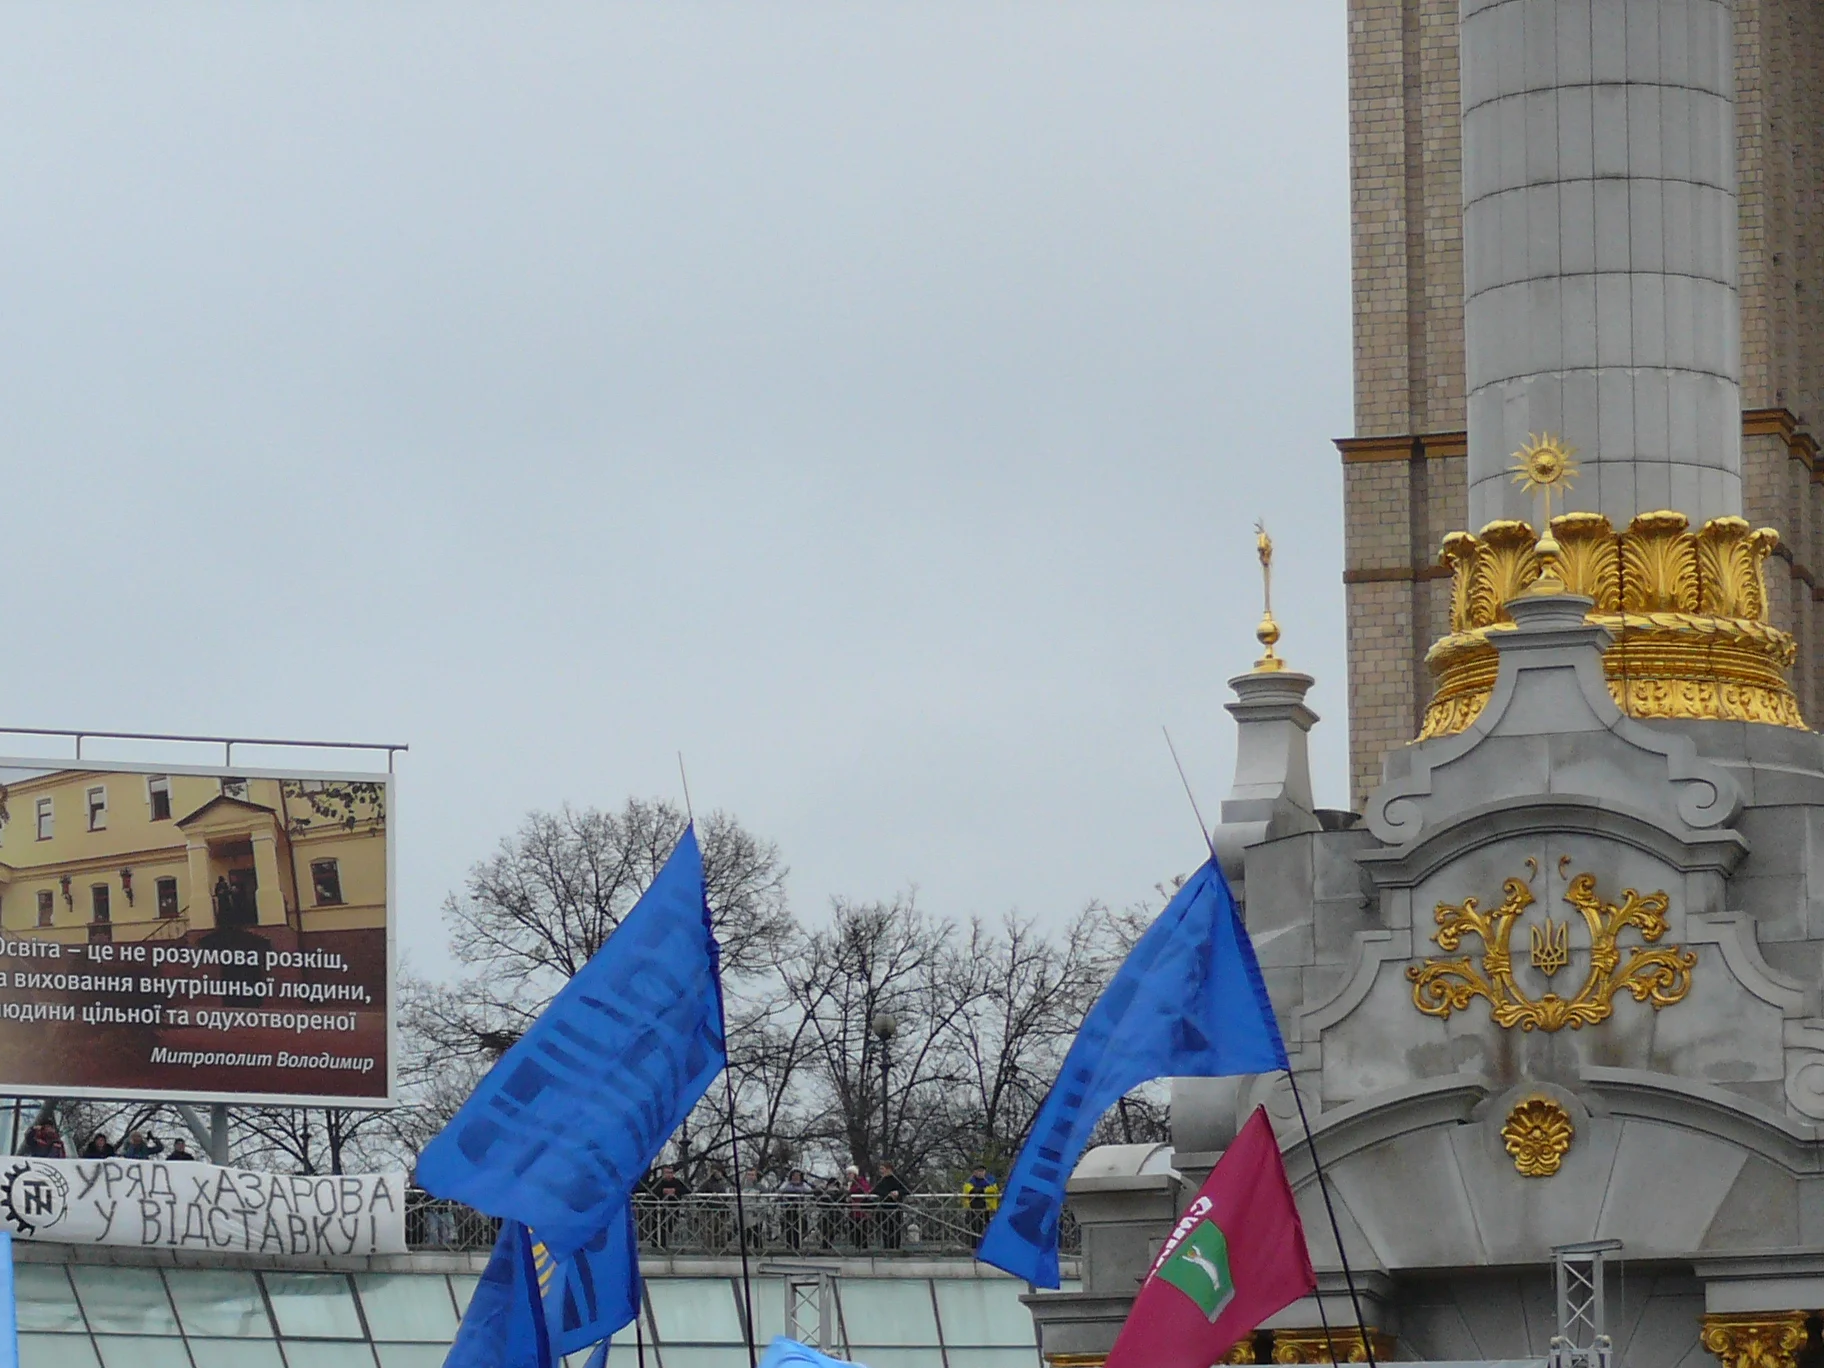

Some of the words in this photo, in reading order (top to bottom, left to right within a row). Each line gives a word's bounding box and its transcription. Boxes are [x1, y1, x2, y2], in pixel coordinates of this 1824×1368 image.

[87, 945, 115, 965] це
[120, 947, 147, 963] не
[152, 948, 260, 968] розумова
[265, 951, 350, 973] розкіш,
[14, 973, 134, 994] виховання
[140, 974, 275, 998] внутрішньої
[279, 982, 373, 1004] людини,
[81, 1005, 162, 1026] цільної
[167, 1011, 190, 1026] та
[196, 1011, 358, 1033] одухотвореної
[150, 1047, 273, 1069] Митрополит
[276, 1051, 375, 1073] Володимир
[76, 1162, 177, 1201] УРЯД
[95, 1200, 117, 1242] У
[139, 1199, 378, 1256] ВІДСТАВКУ!
